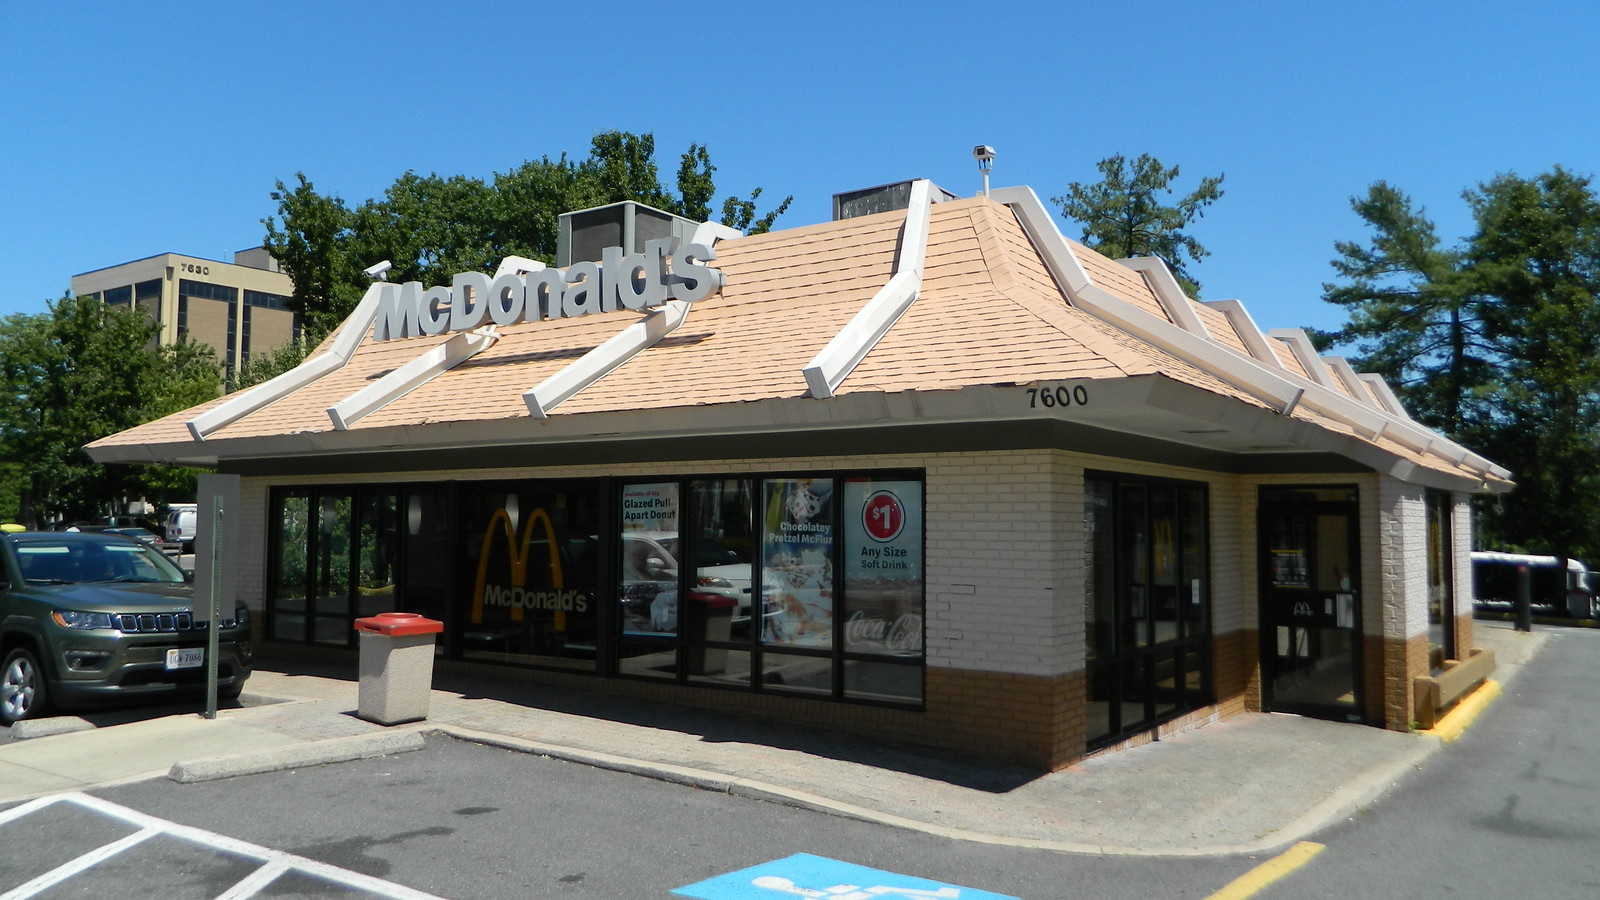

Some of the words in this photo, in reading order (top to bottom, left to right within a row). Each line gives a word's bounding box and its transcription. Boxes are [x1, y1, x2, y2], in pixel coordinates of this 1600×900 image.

[181, 262, 209, 275] 7630
[373, 237, 719, 341] McDonald's
[1026, 385, 1087, 408] 7600
[624, 499, 653, 508] Glazed
[655, 498, 671, 507] Pull
[625, 511, 648, 521] Apart
[650, 510, 676, 519] Donut
[873, 505, 890, 529] $1
[780, 521, 830, 534] Chocolatey
[769, 533, 800, 543] Pretzel
[861, 546, 881, 559] Any
[883, 546, 907, 557] Size
[861, 560, 880, 568] Soft
[882, 560, 908, 569] Drink
[484, 584, 587, 612] McDonald's
[846, 610, 922, 650] Coca-Col
